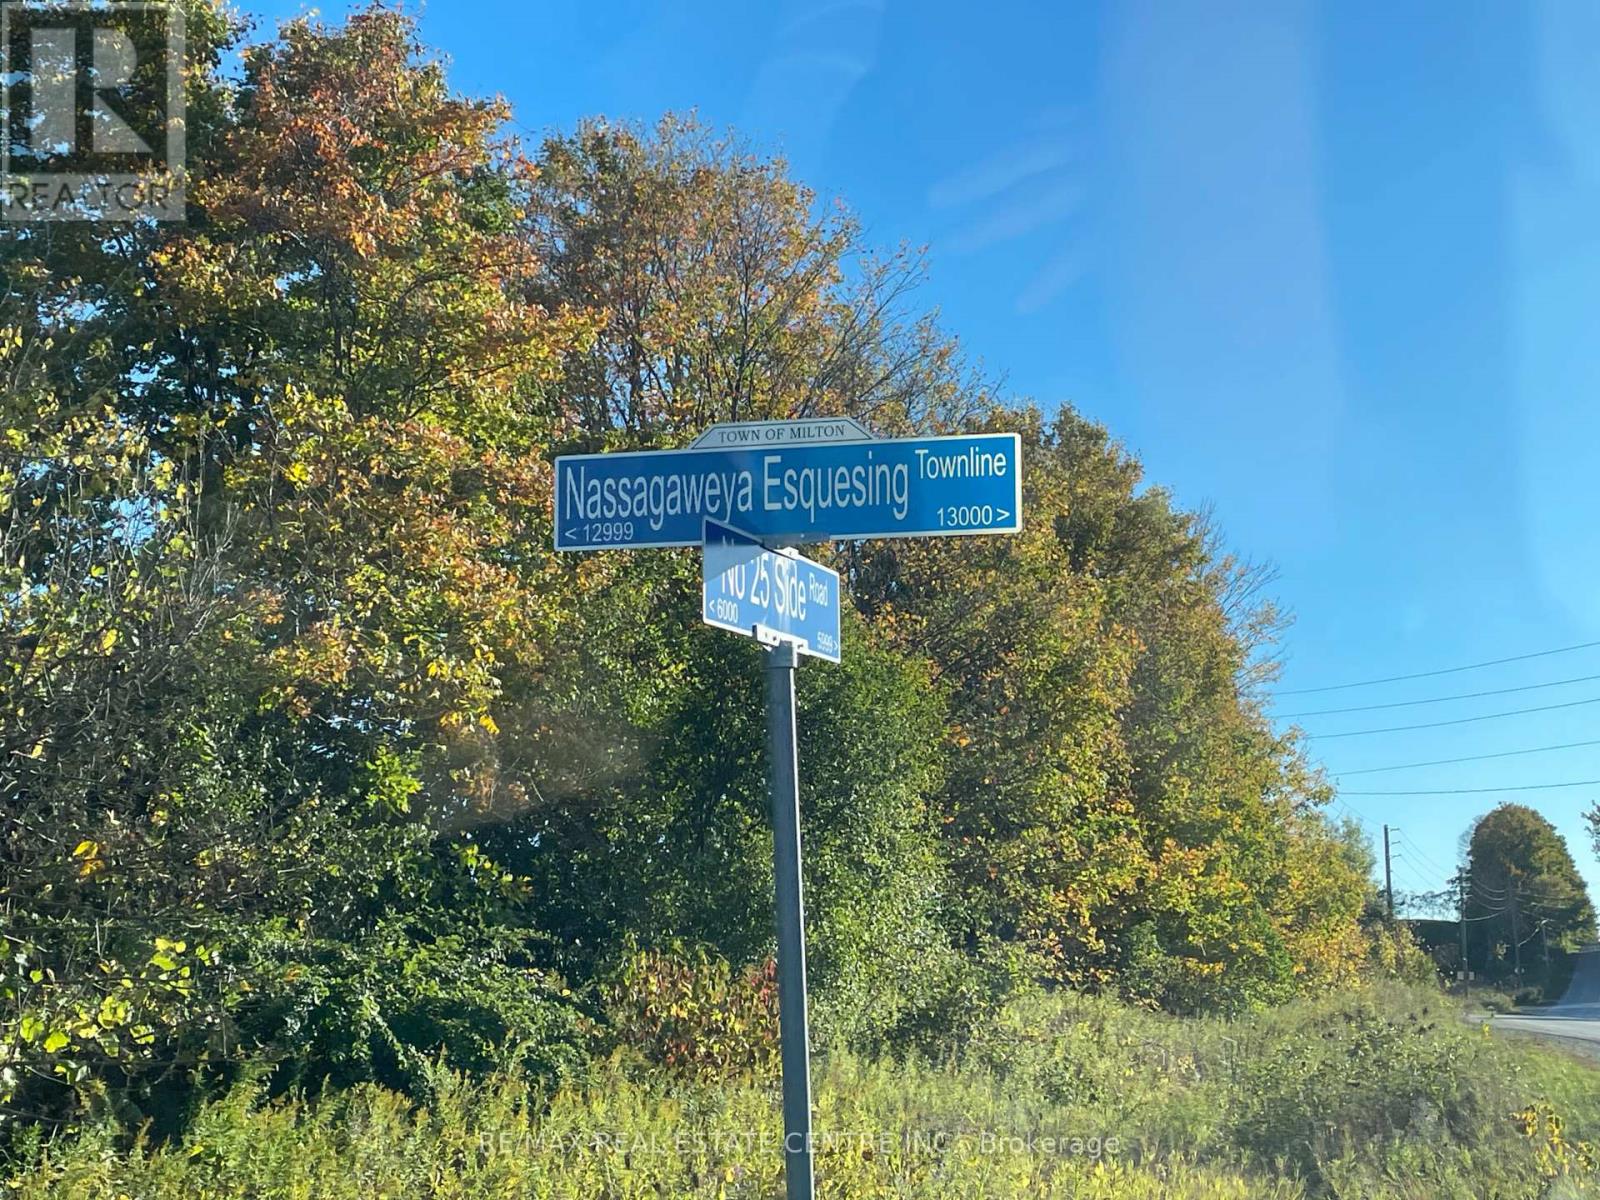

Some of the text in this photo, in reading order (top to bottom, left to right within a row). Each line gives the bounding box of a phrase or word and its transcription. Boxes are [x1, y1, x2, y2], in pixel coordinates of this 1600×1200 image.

[719, 424, 846, 443] TOWN OF MILTON
[915, 447, 1007, 480] Townline
[566, 450, 909, 531] Nassagaweya Esquesing
[937, 505, 993, 527] 13000
[583, 522, 634, 542] 12999
[750, 552, 770, 609] 25
[774, 556, 807, 621] Side
[808, 572, 829, 607] Road
[717, 598, 739, 624] 6000
